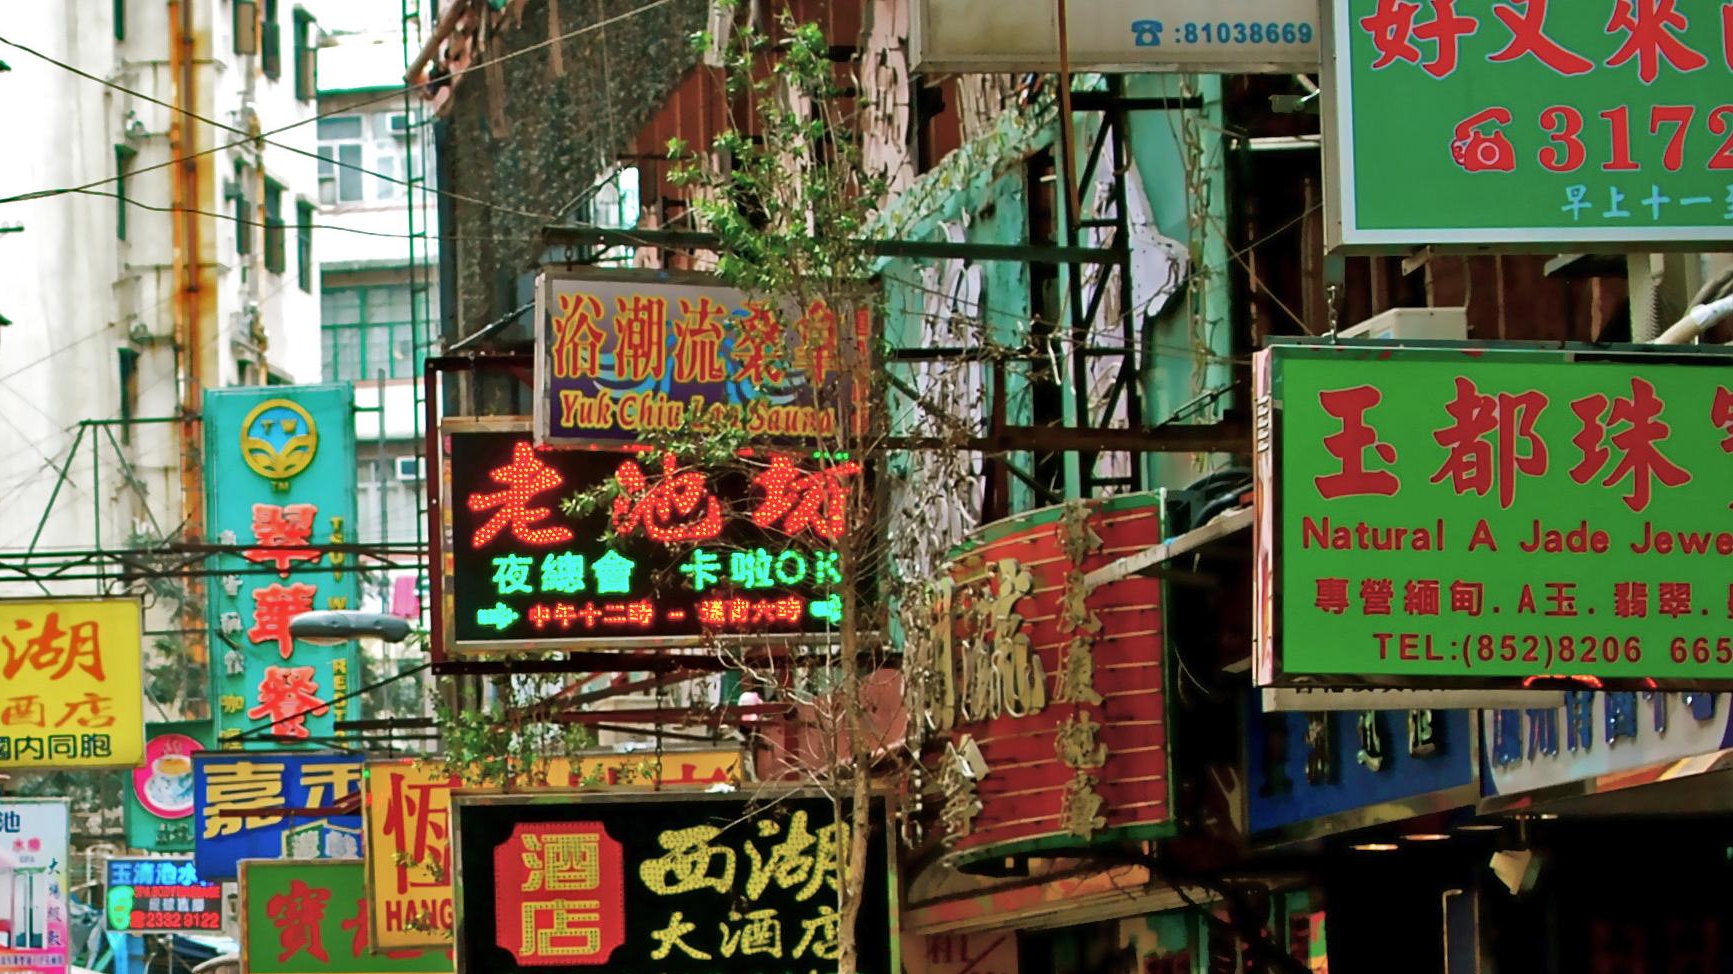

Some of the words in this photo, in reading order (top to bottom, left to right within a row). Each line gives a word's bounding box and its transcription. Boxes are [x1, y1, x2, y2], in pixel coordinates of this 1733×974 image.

[1360, 0, 1733, 84] 好又來
[1538, 105, 1733, 173] 3172
[559, 390, 613, 428] Yuk
[618, 391, 684, 430] Chiu
[1314, 375, 1733, 513] 玉都珠
[1302, 515, 1446, 552] Natural
[1468, 519, 1499, 553] A
[1519, 519, 1612, 555] Jade
[491, 549, 636, 595] 夜總會
[639, 809, 853, 901] 西湖
[518, 832, 601, 957] 酒店
[649, 905, 844, 960] 大酒店
